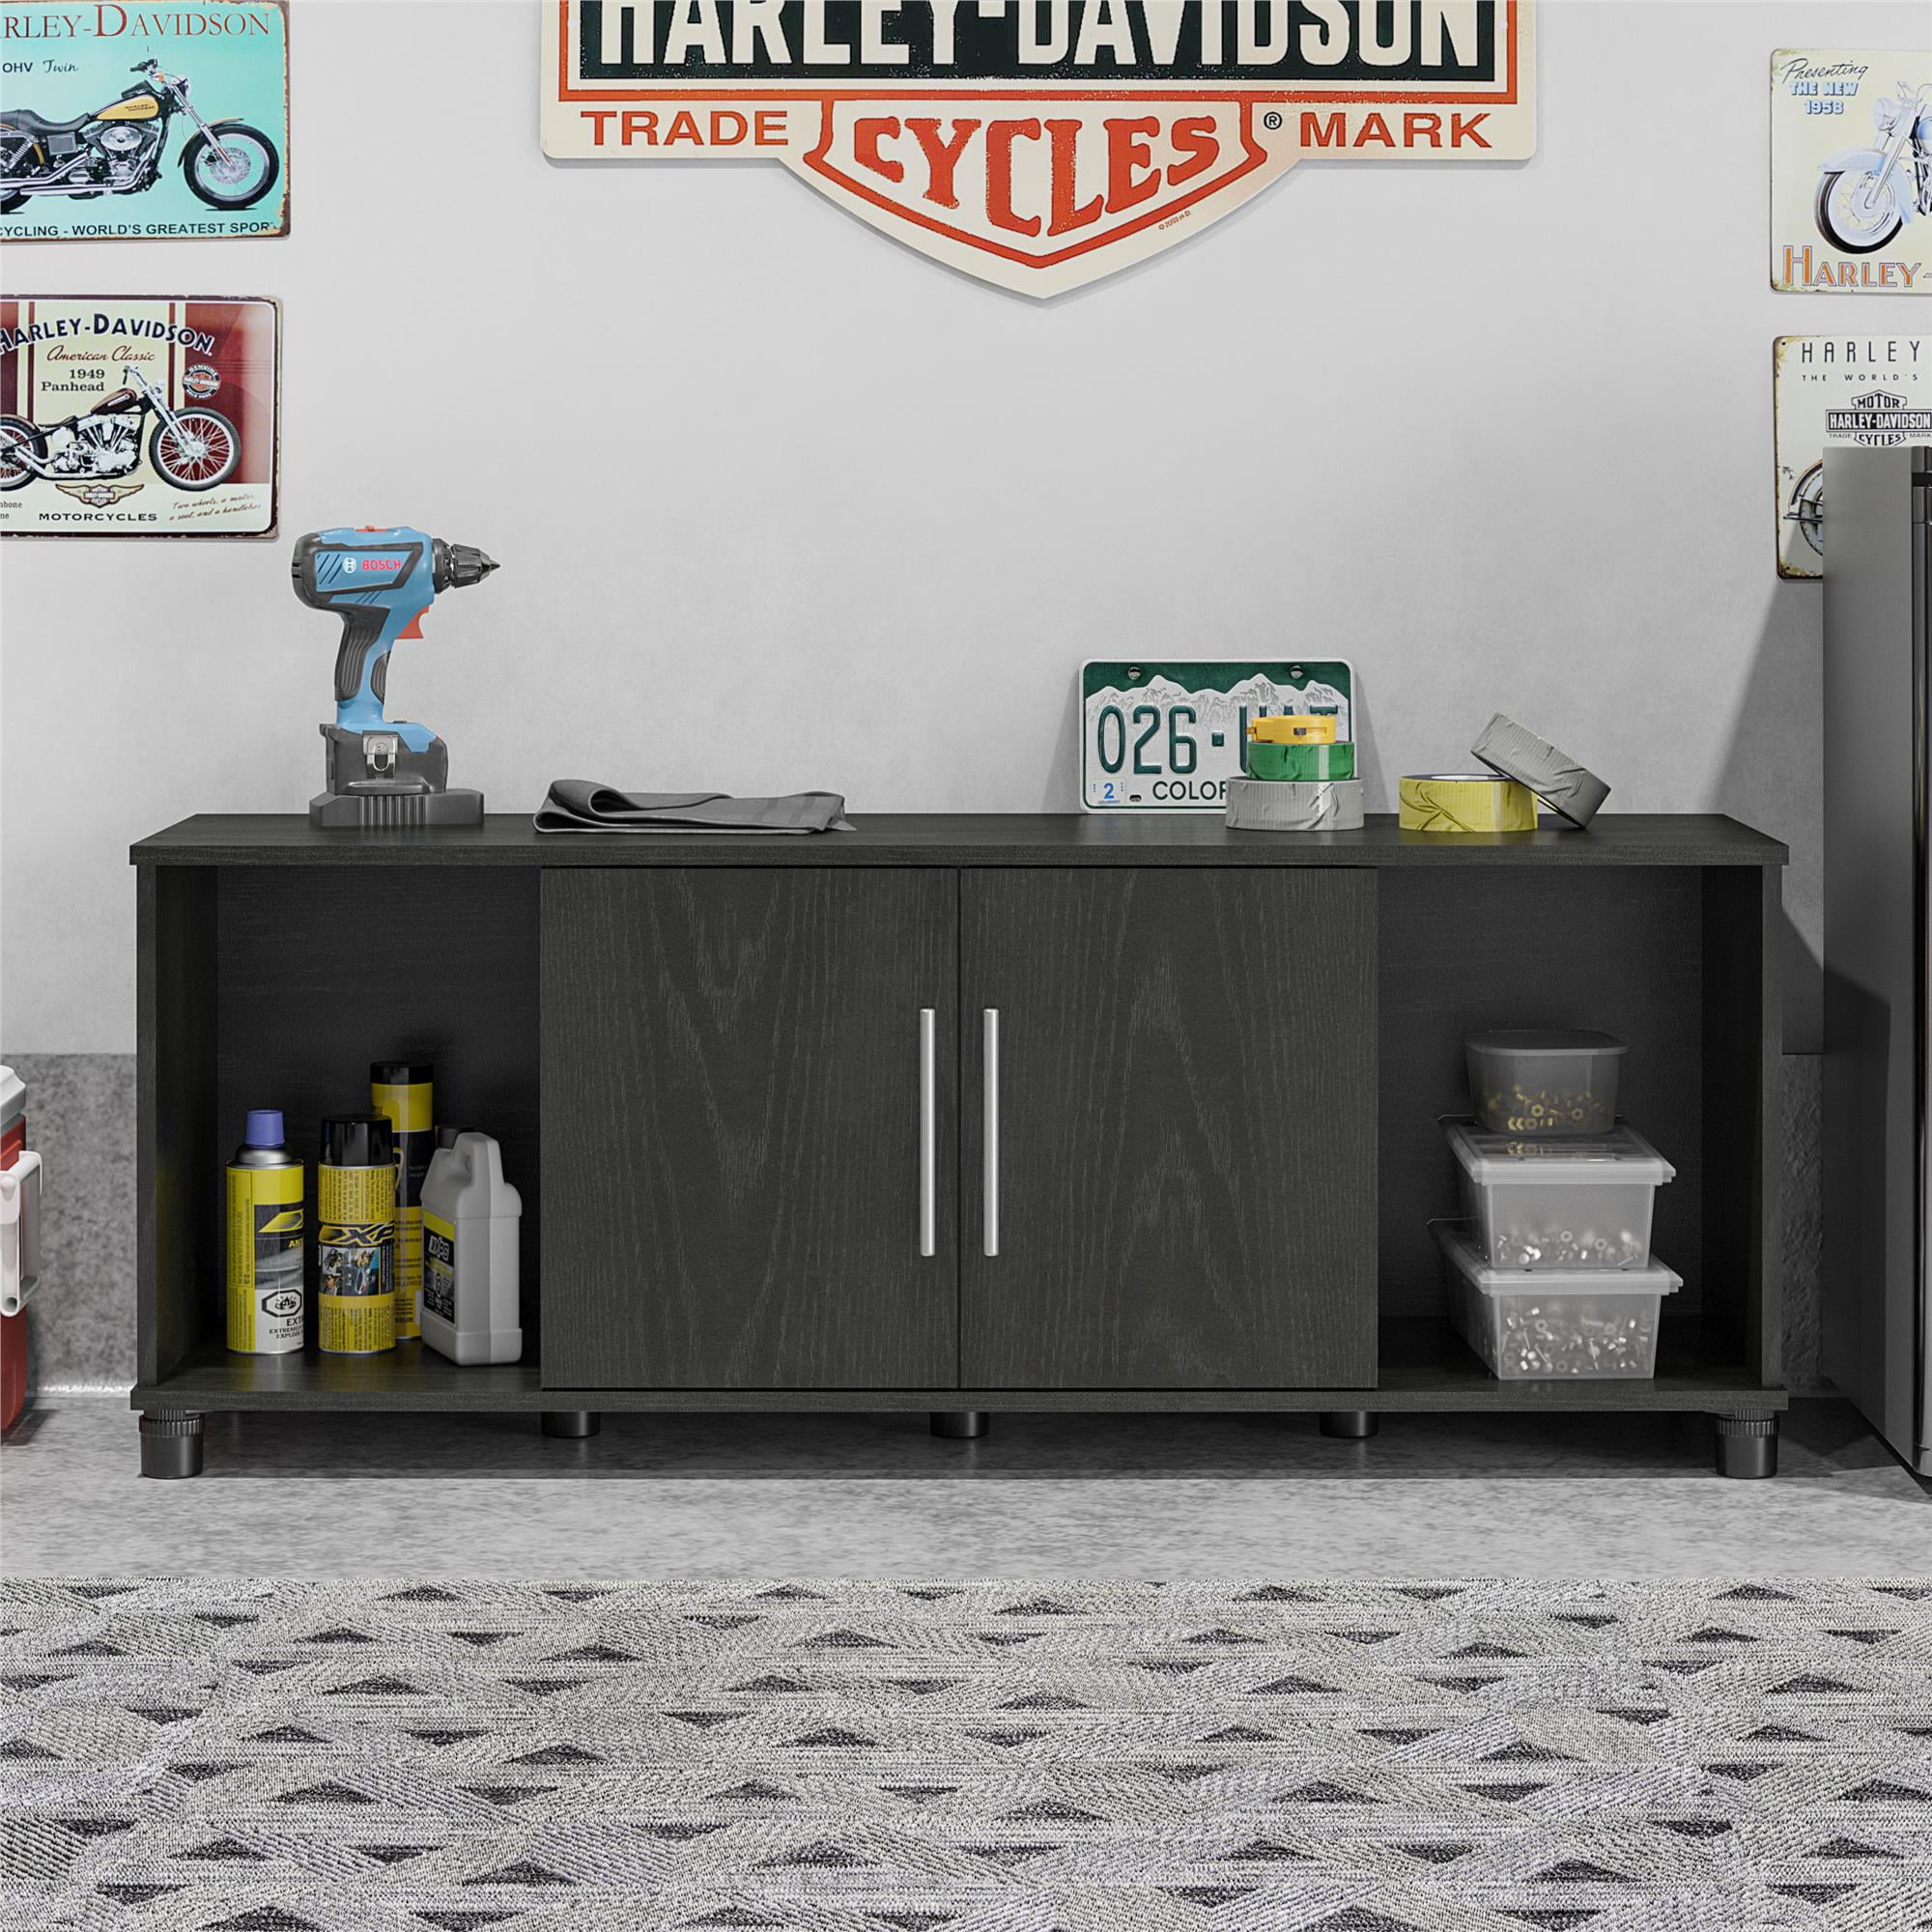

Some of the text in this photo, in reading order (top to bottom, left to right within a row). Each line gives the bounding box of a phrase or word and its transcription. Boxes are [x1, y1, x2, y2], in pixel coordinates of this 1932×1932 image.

[0, 4, 270, 38] RLEY-DAVIDSON
[601, 0, 1480, 68] HARLEY-DAVIDSON
[2, 59, 78, 73] OHV Twin
[1780, 58, 1869, 84] Presenting
[1790, 81, 1859, 97] THE NEW
[1804, 99, 1844, 115] 1958
[581, 111, 788, 146] TRADE
[1299, 112, 1492, 148] MARK
[854, 115, 1220, 237] CYCLES
[0, 225, 58, 237] YCLING
[72, 224, 141, 236] WORLD'S
[146, 223, 225, 235] GREATEST
[46, 345, 155, 361] American Classic
[1802, 341, 1919, 362] HARLEY
[70, 368, 105, 380] 1949
[1844, 373, 1918, 382] WORLD'S
[41, 382, 105, 391] Panhead
[1858, 393, 1900, 409] MOTOR
[1829, 413, 1931, 429] HARLEY-DAVIDSON
[39, 513, 157, 522] MOTORCYCLES
[362, 559, 401, 571] BOSCH
[1103, 782, 1114, 799] 2
